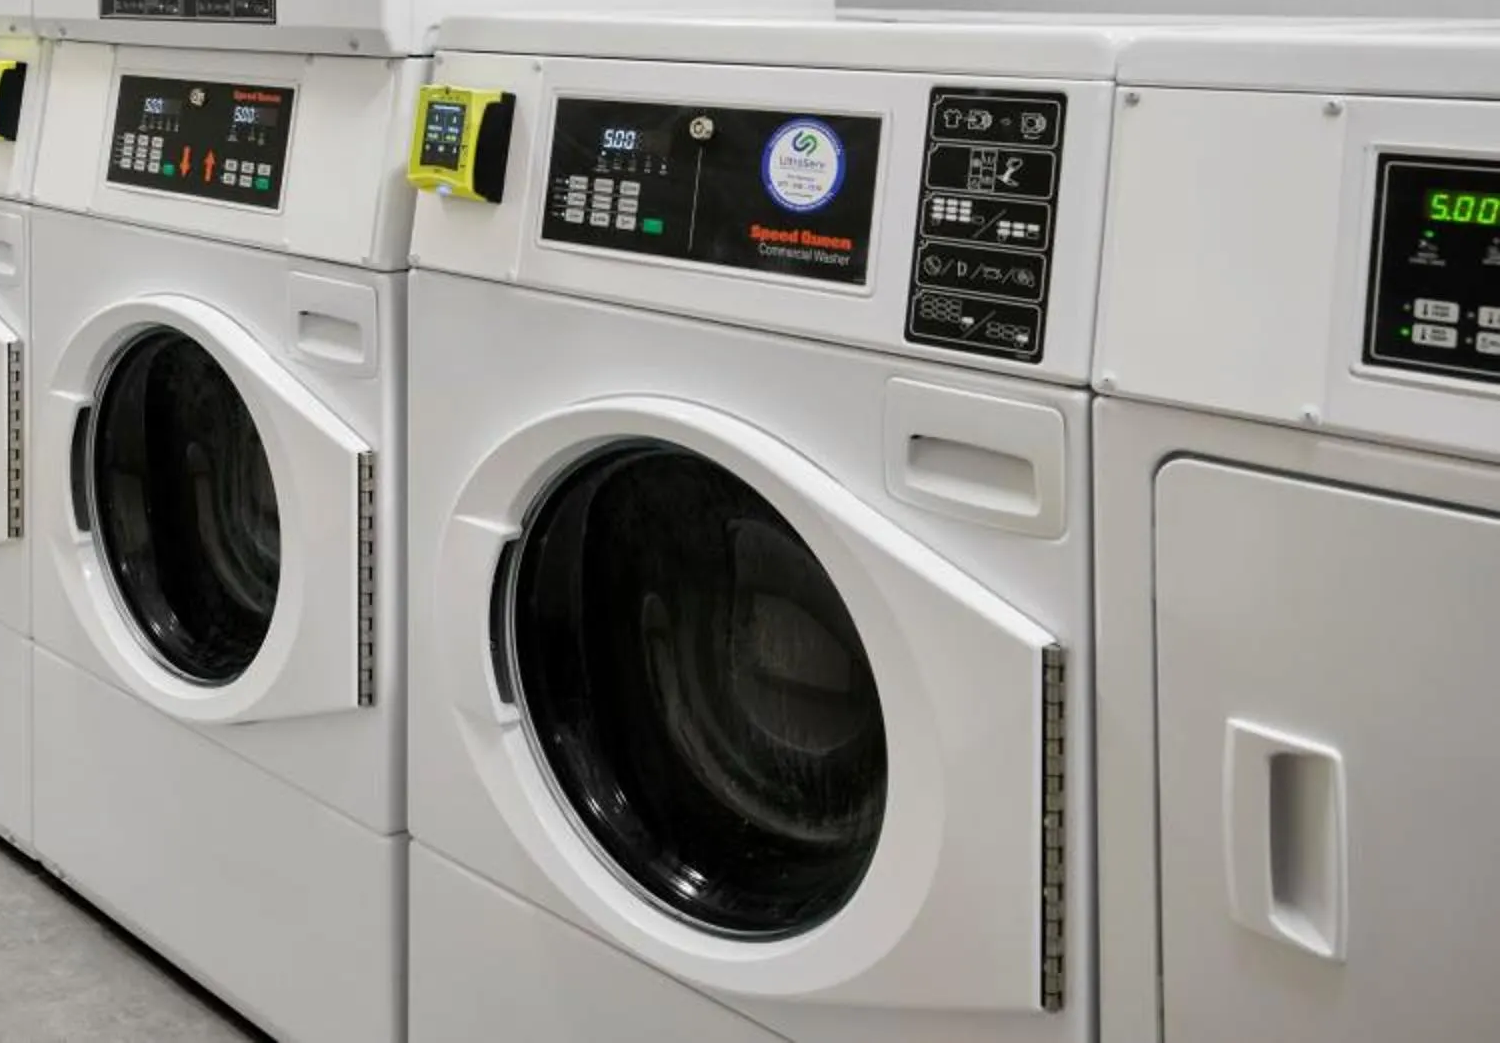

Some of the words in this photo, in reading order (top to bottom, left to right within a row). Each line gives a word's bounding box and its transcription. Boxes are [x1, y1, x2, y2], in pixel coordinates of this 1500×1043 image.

[1429, 192, 1500, 226] 5.00
[750, 223, 800, 244] Speed
[801, 230, 852, 250] Queen
[758, 242, 813, 261] Commercial
[814, 248, 851, 267] Washer
